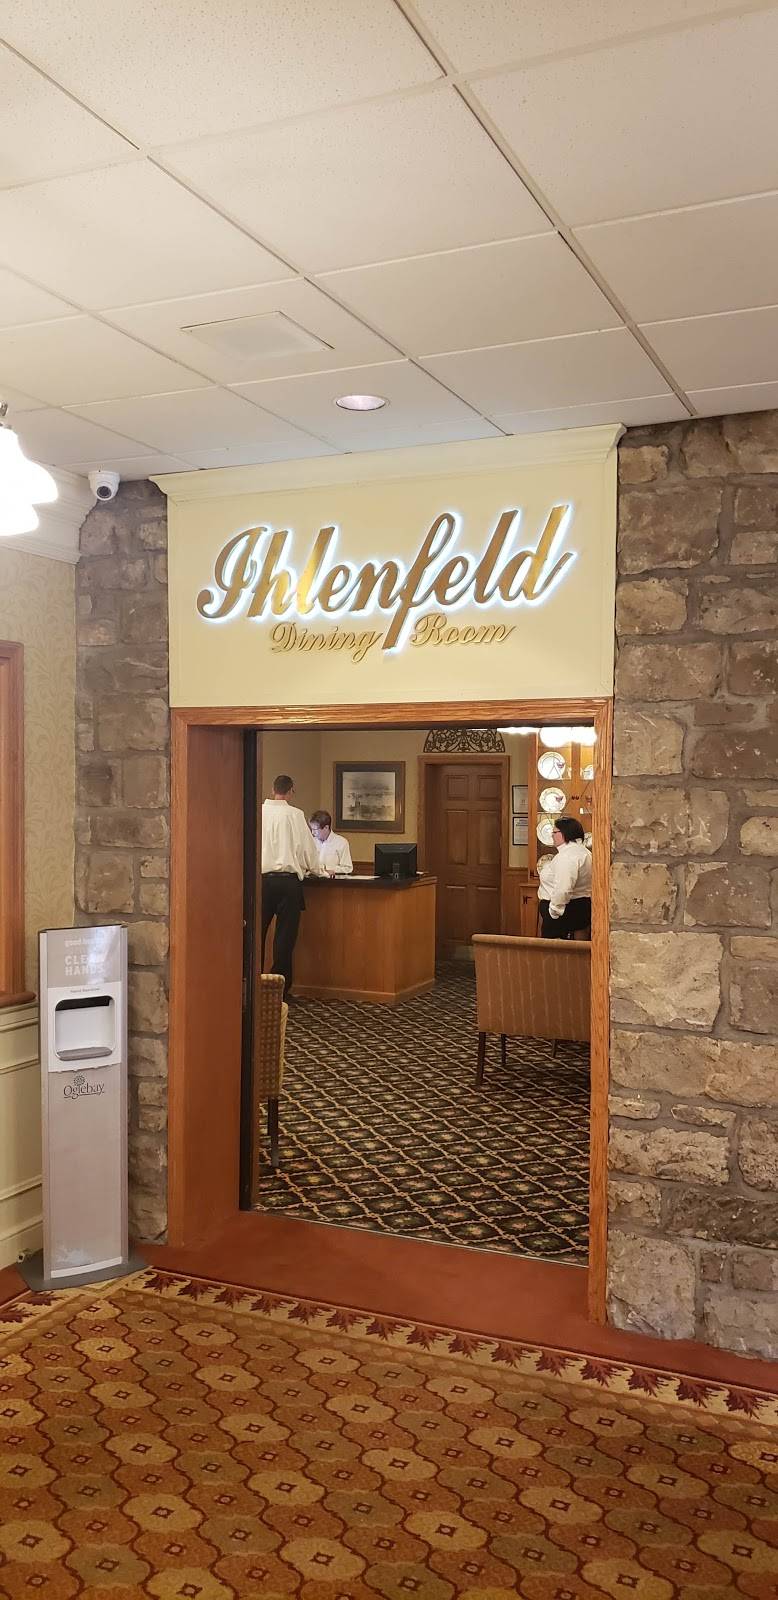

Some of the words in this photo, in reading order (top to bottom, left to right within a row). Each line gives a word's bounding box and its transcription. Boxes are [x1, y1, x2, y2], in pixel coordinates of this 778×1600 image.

[197, 504, 574, 650] Ihlenfeld
[270, 621, 381, 663] Dining
[411, 612, 516, 647] Room
